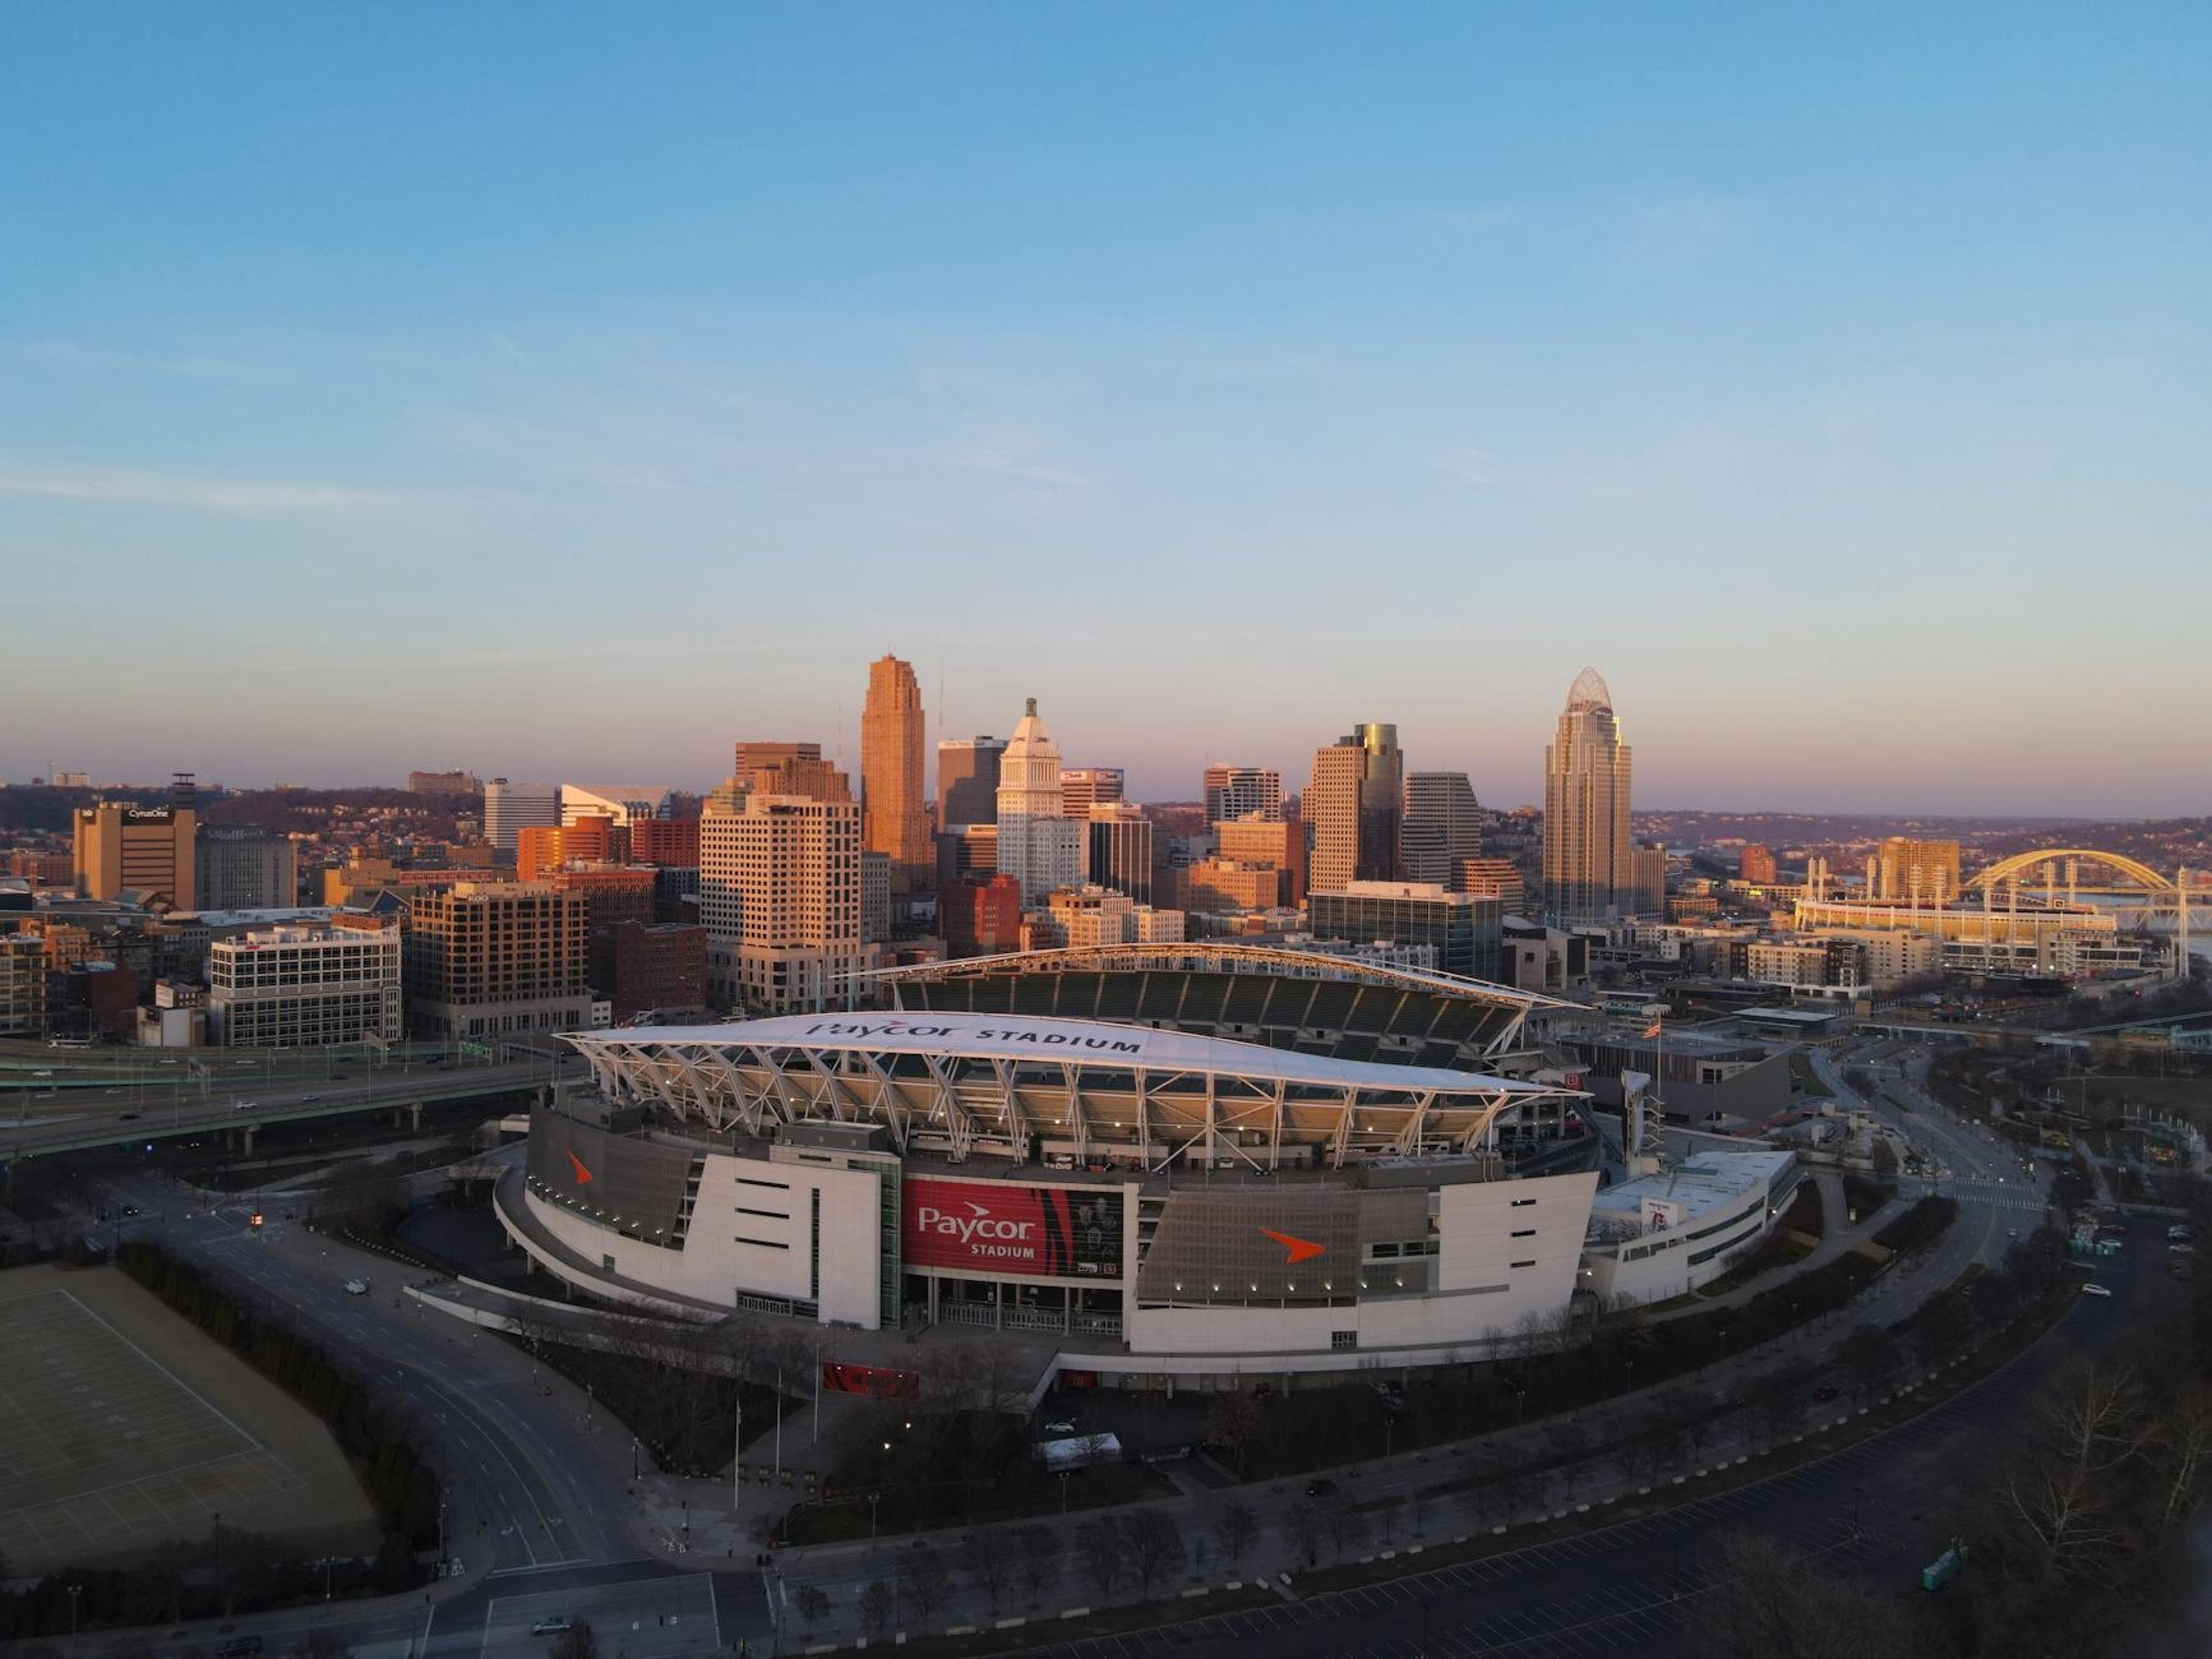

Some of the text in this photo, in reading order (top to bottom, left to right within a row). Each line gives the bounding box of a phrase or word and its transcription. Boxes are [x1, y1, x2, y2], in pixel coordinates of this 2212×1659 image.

[128, 810, 169, 818] CyrusOne
[806, 1024, 1141, 1053] Paycor STADIUM
[918, 1207, 1036, 1244] Paycor
[971, 1244, 1035, 1258] STADIUM
